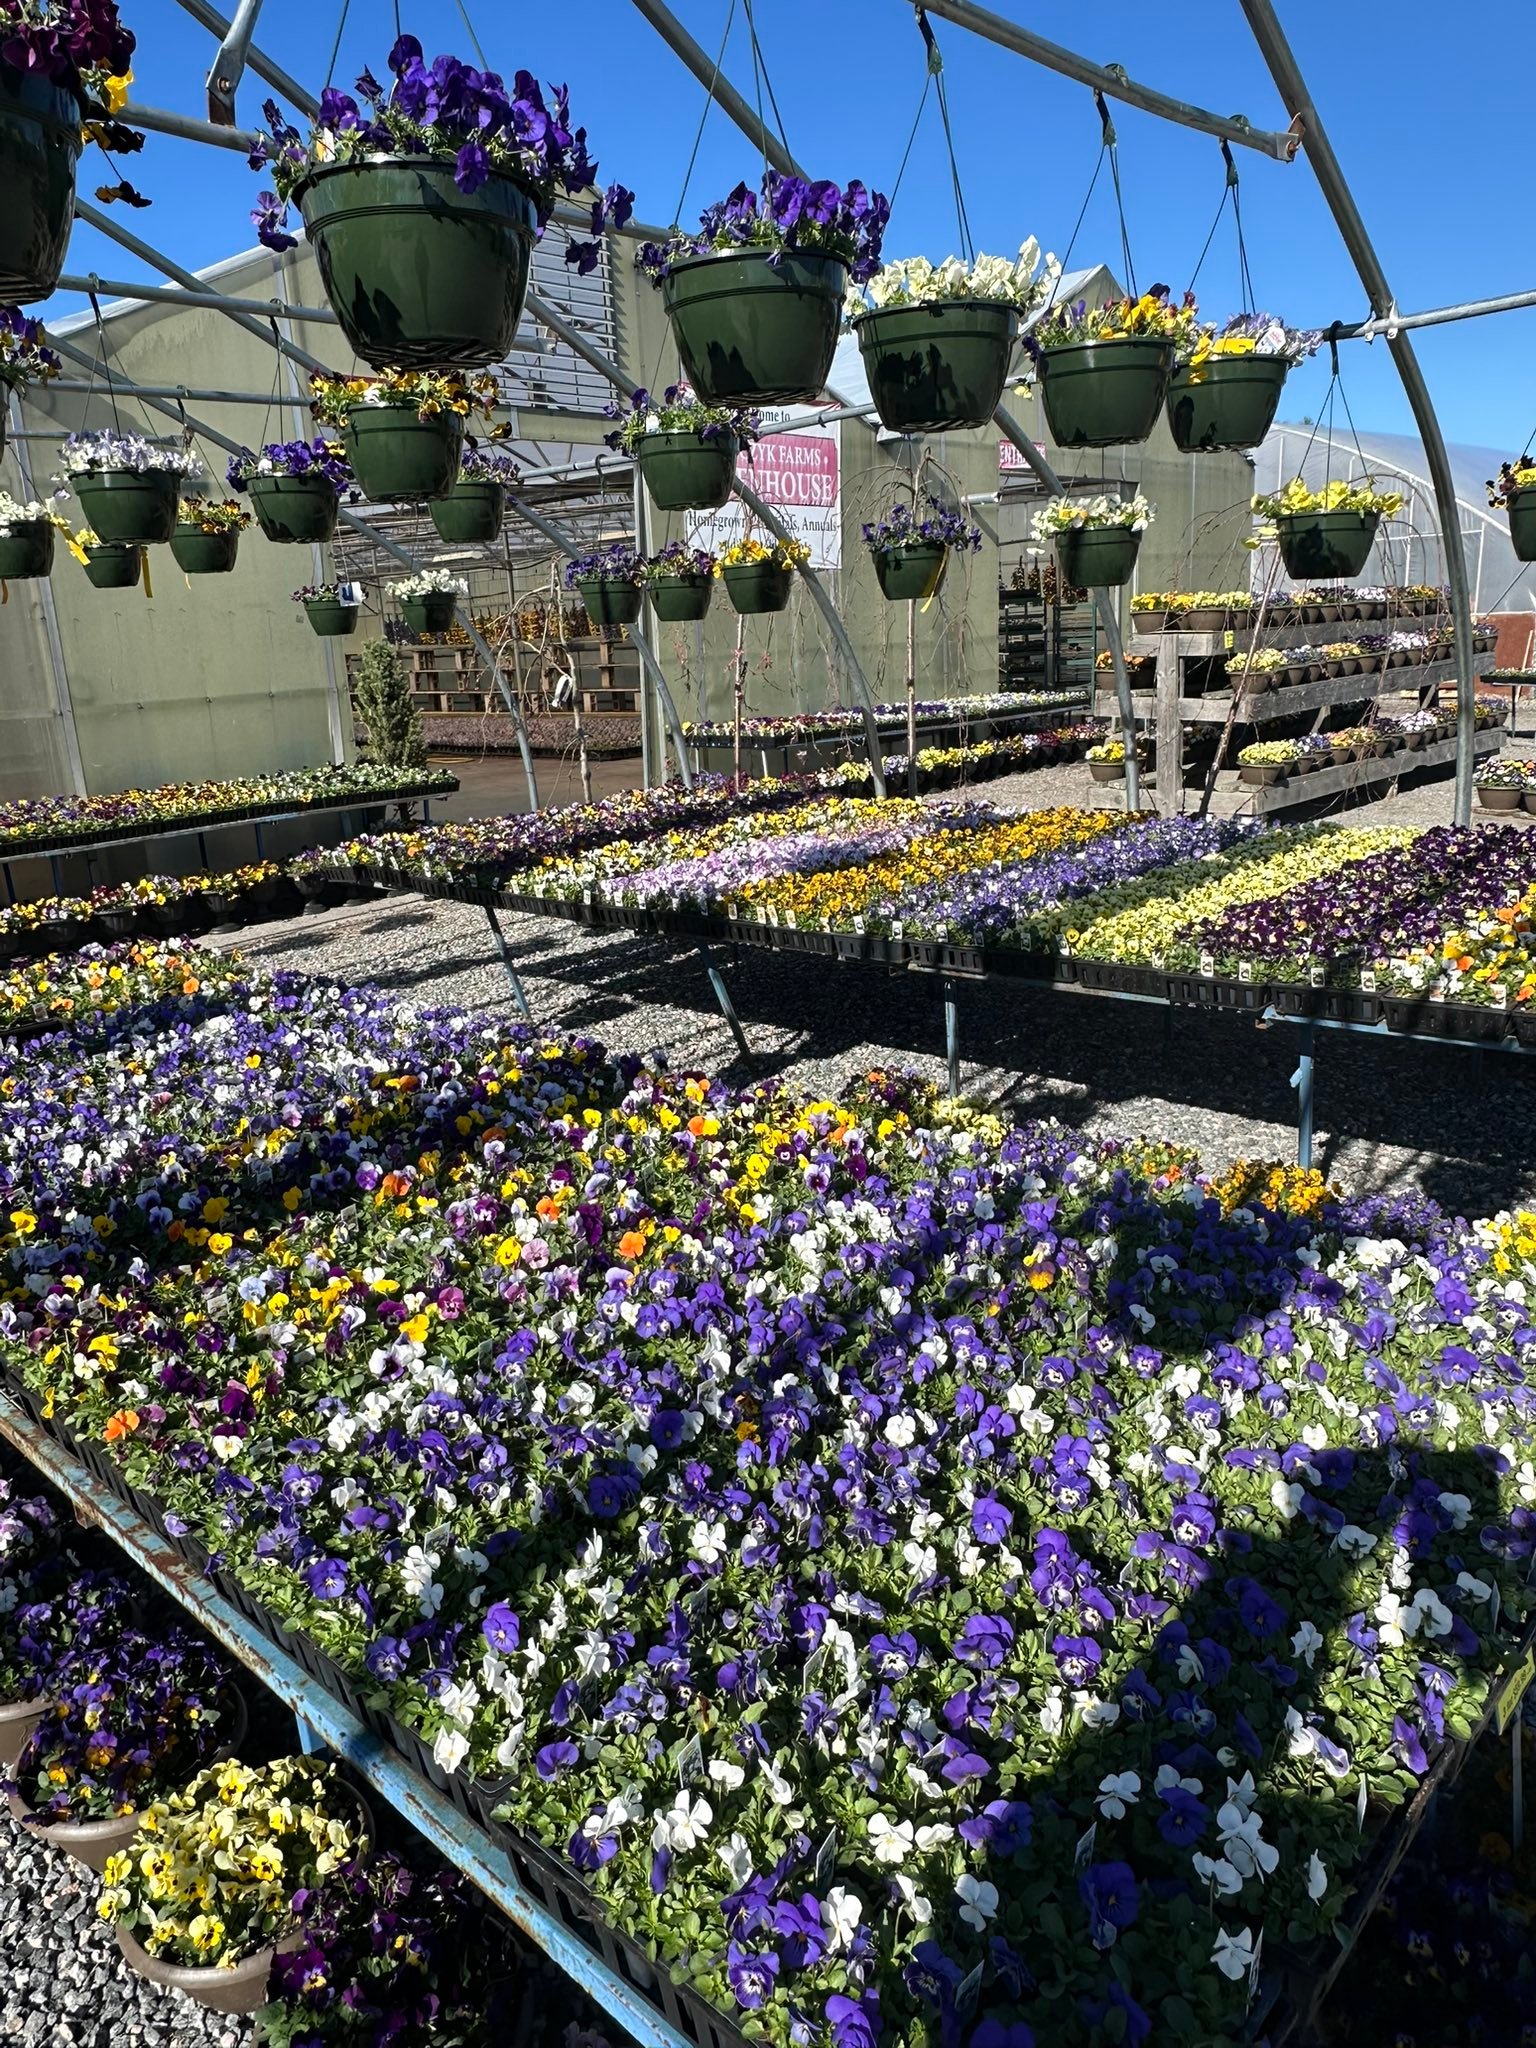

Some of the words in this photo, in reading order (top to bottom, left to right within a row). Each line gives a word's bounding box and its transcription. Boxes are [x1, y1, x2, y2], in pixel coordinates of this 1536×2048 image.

[781, 410, 791, 423] to
[778, 445, 821, 466] FARMS
[802, 516, 837, 532] Annuals
